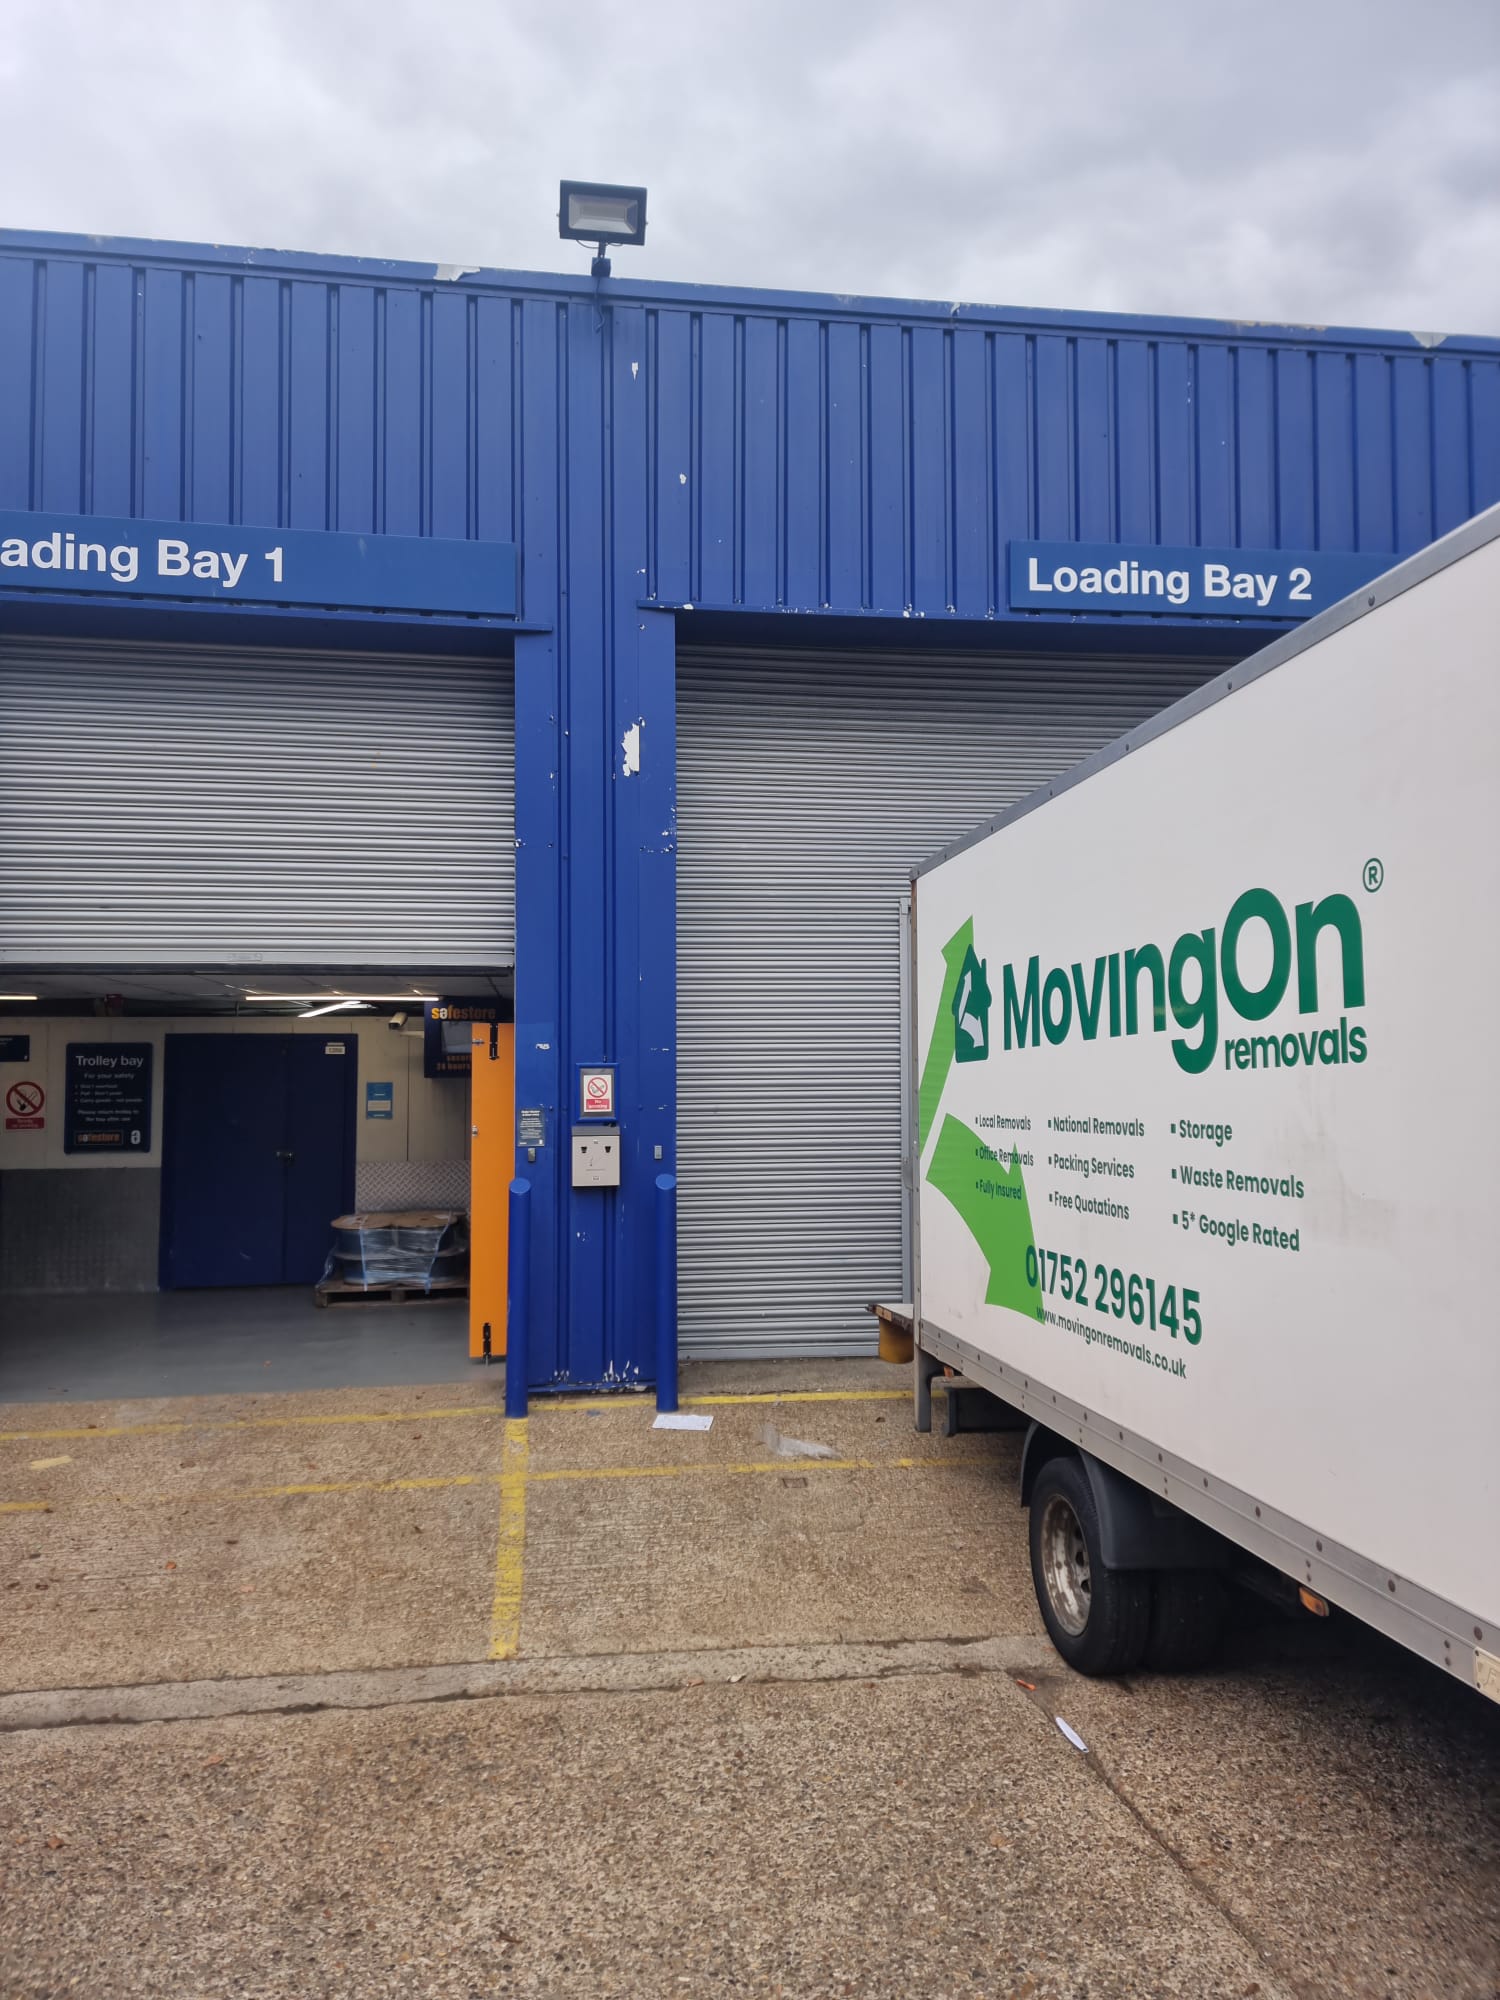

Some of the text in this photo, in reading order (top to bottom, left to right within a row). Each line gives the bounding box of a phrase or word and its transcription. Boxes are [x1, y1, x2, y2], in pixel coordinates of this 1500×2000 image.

[157, 539, 249, 588] Bay
[264, 547, 284, 583] 1
[1029, 557, 1313, 608] Loading Bay 2
[431, 1004, 496, 1020] safestore
[1224, 1016, 1368, 1070] removals
[75, 1055, 144, 1068] Trolley bay
[97, 1073, 112, 1081] your
[979, 1114, 1032, 1131] Local Removals
[1053, 1115, 1145, 1137] National Removals
[1179, 1119, 1233, 1148] Storage
[979, 1145, 1034, 1167] Office Removals
[1053, 1153, 1135, 1179] Packing Services
[979, 1178, 1022, 1201] Fully Insured
[1180, 1164, 1305, 1199] Waste Removals
[1053, 1191, 1130, 1220] Free Quotations
[1199, 1213, 1250, 1248] Google
[1251, 1223, 1301, 1252] Rated
[1025, 1244, 1203, 1346] 01752 296145
[1036, 1305, 1187, 1379] www.movingonremovals.co.uk
